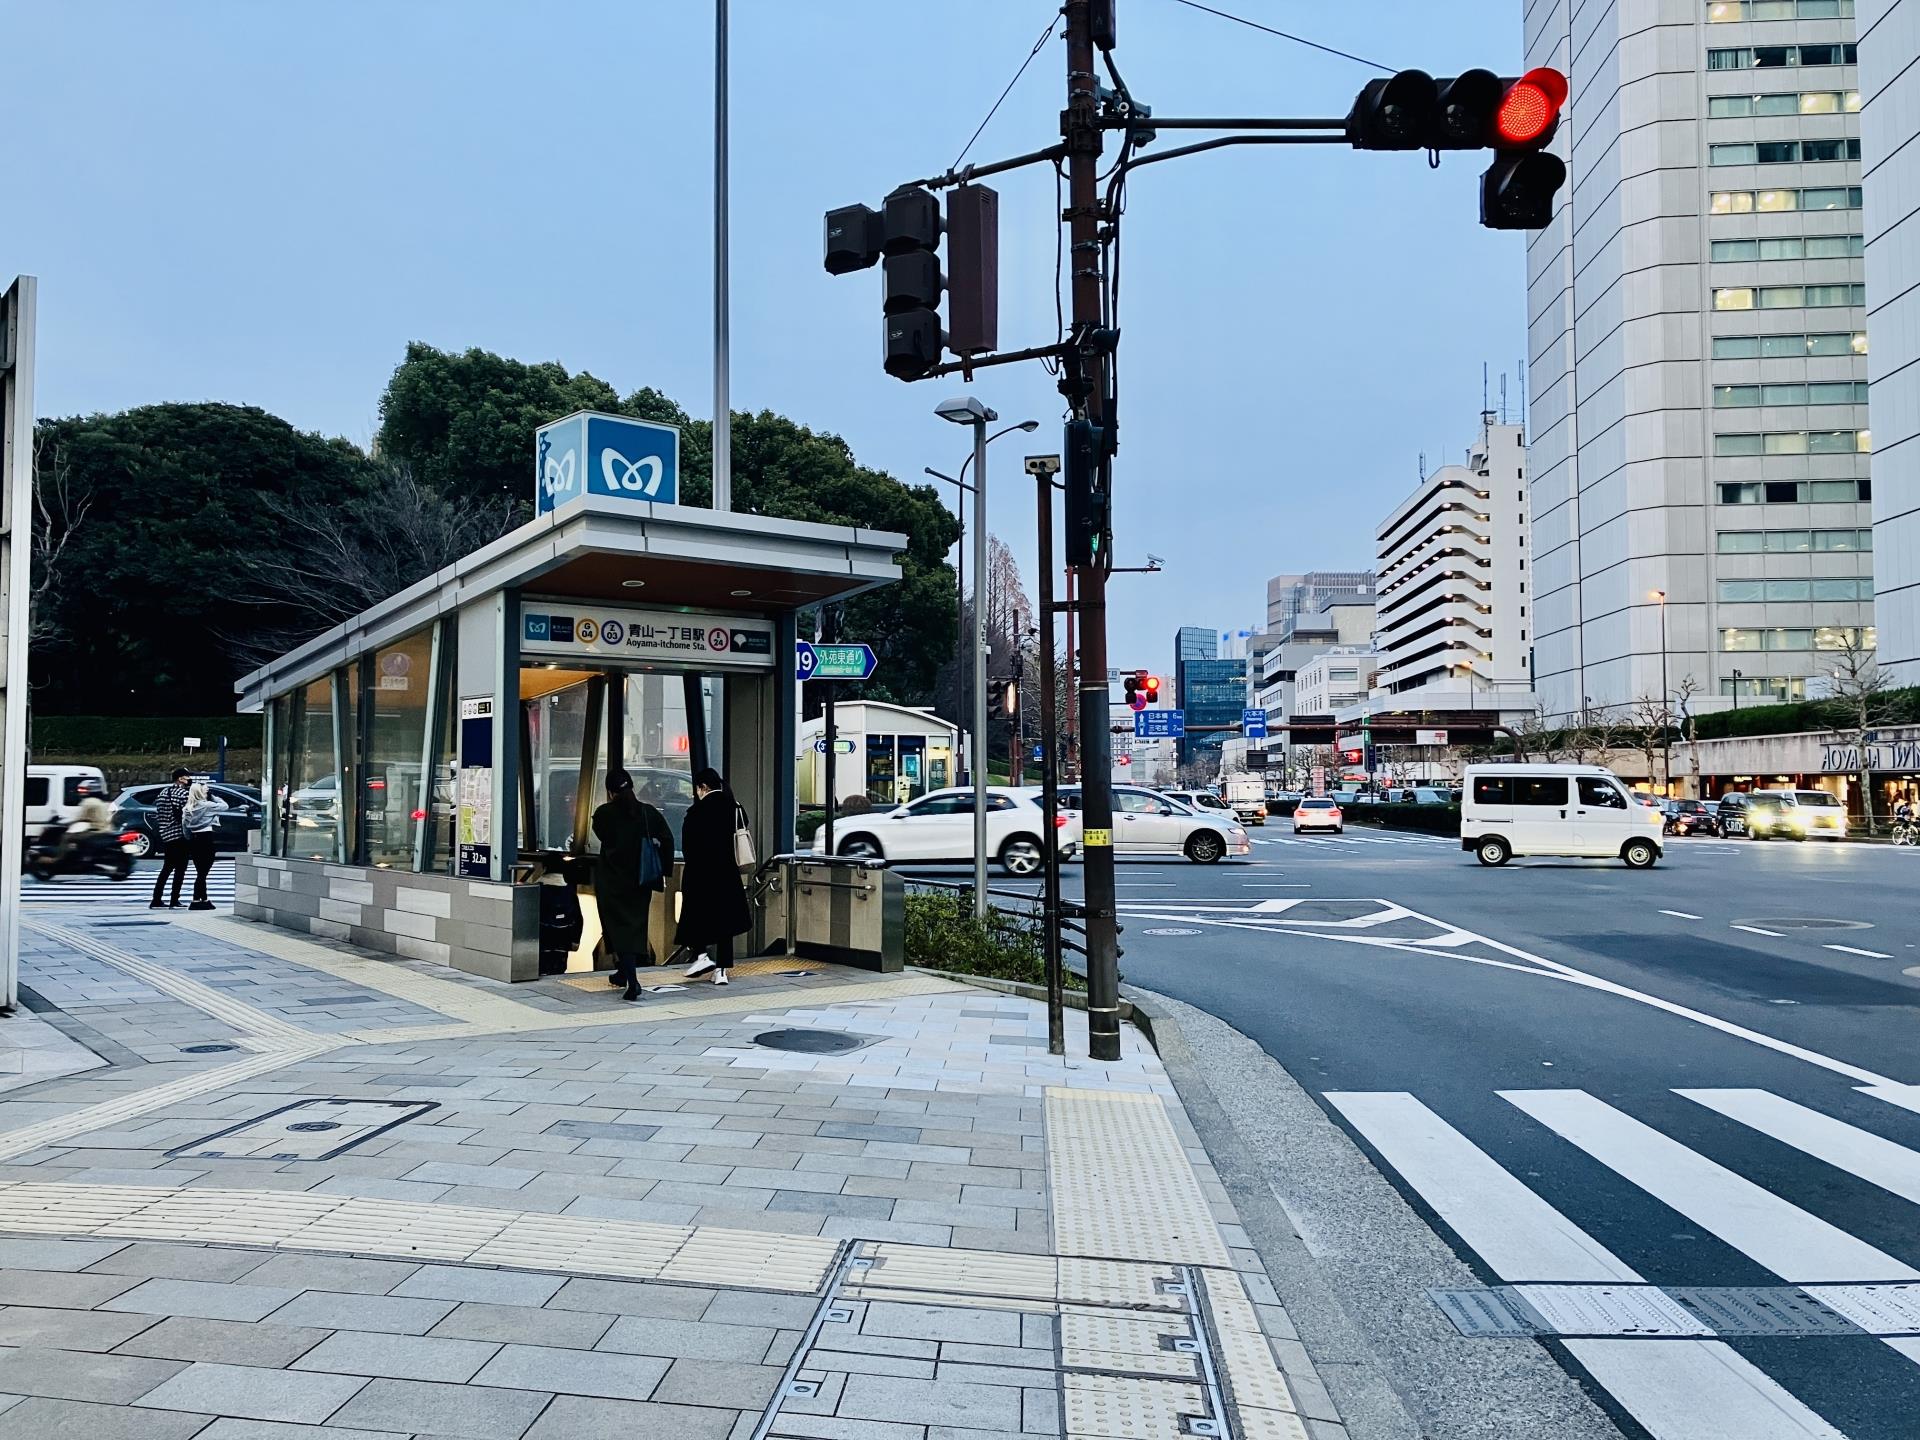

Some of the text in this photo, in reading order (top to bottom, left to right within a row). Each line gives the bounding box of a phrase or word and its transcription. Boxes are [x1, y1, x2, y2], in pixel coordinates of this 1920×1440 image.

[581, 630, 593, 638] 04
[606, 632, 618, 640] 03
[629, 624, 705, 641] 青山一丁目駅
[626, 638, 707, 651] Aoyama-itchome Sta.
[713, 638, 723, 646] 24
[820, 650, 863, 665] 外苑東通り
